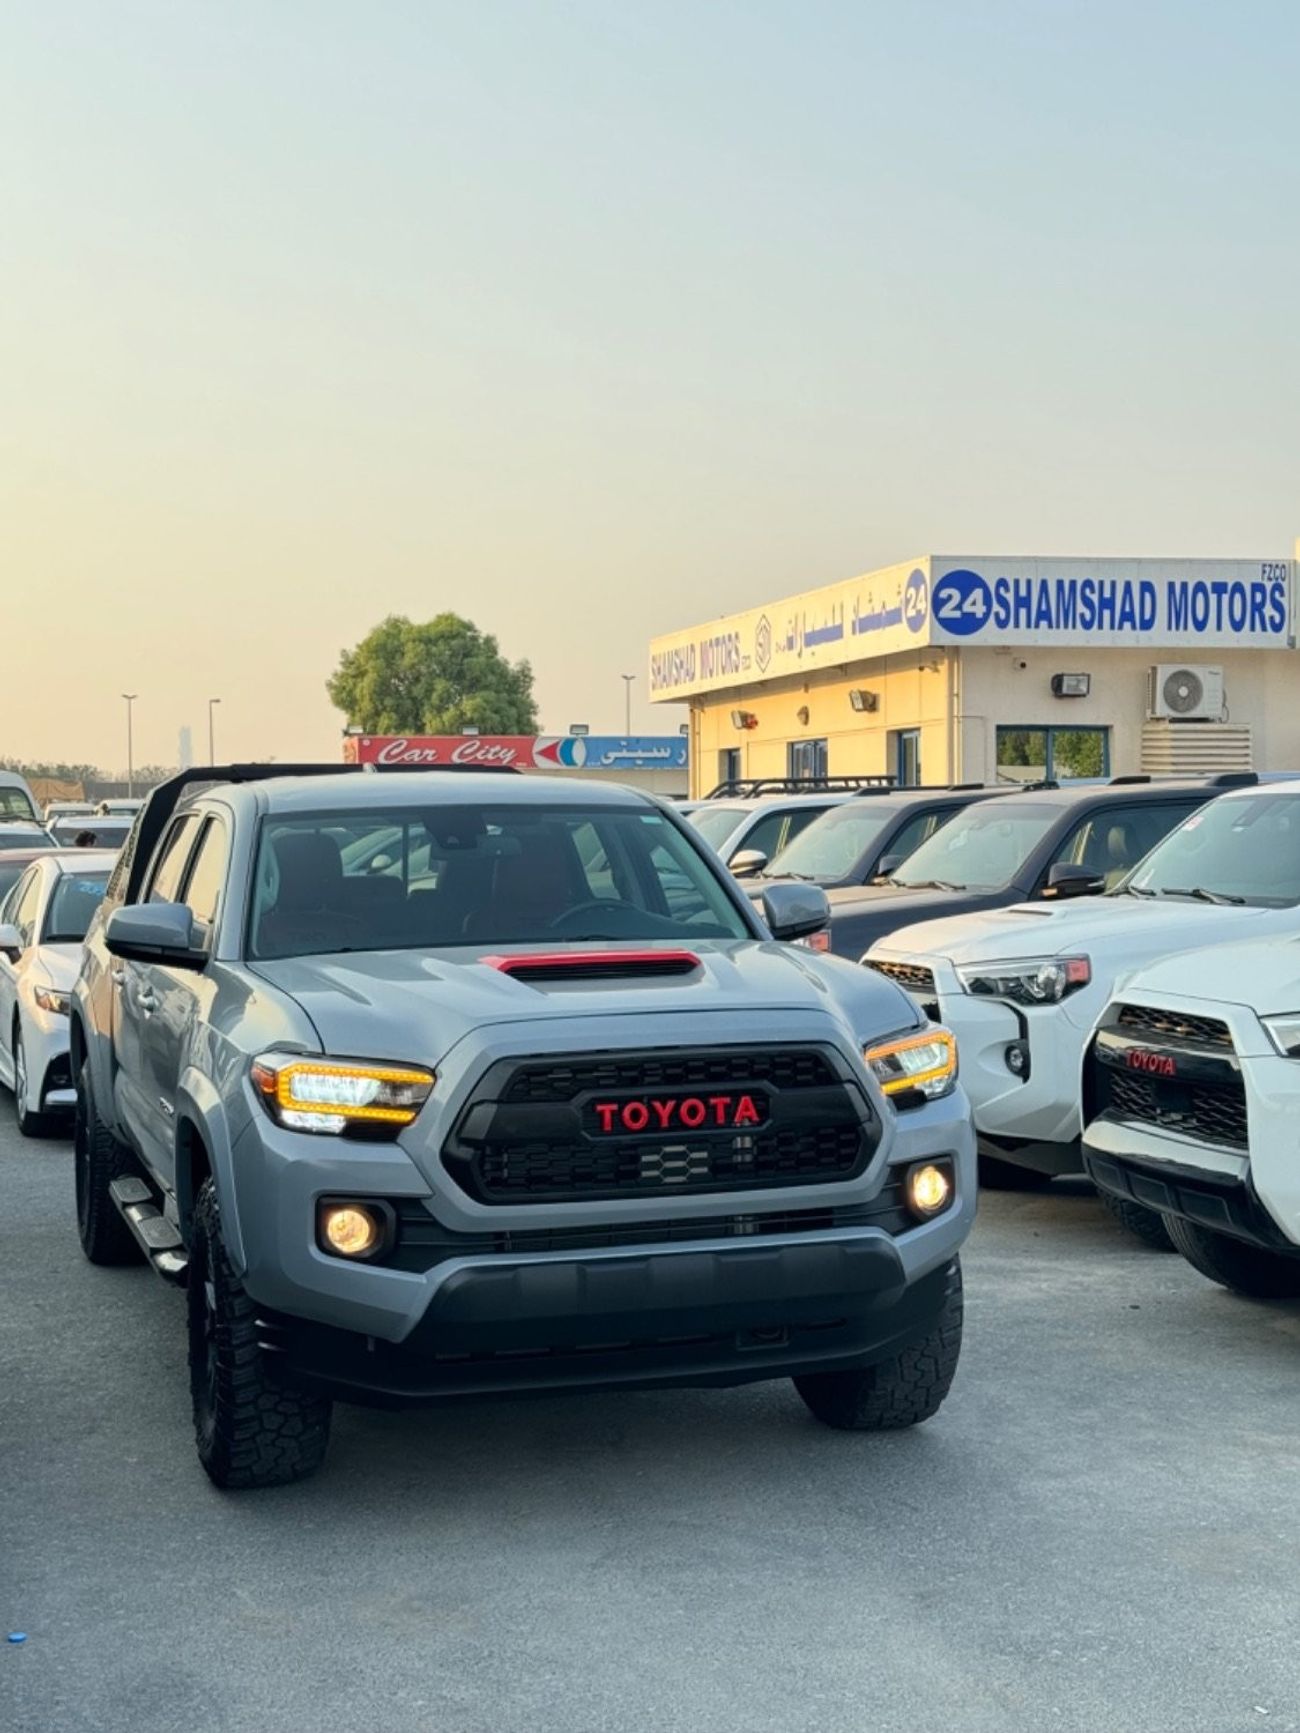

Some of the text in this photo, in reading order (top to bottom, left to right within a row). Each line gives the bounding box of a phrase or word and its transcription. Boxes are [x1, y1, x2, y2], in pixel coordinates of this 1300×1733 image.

[1261, 563, 1287, 582] FZCO
[907, 584, 927, 618] 24
[938, 577, 1287, 634] 24 SHAMSHAD MOTORS
[700, 631, 741, 680] MOTORS
[377, 739, 438, 764] Car
[451, 739, 518, 764] City
[1126, 1049, 1176, 1076] TOYOTA
[596, 1095, 760, 1132] TOYOTA
